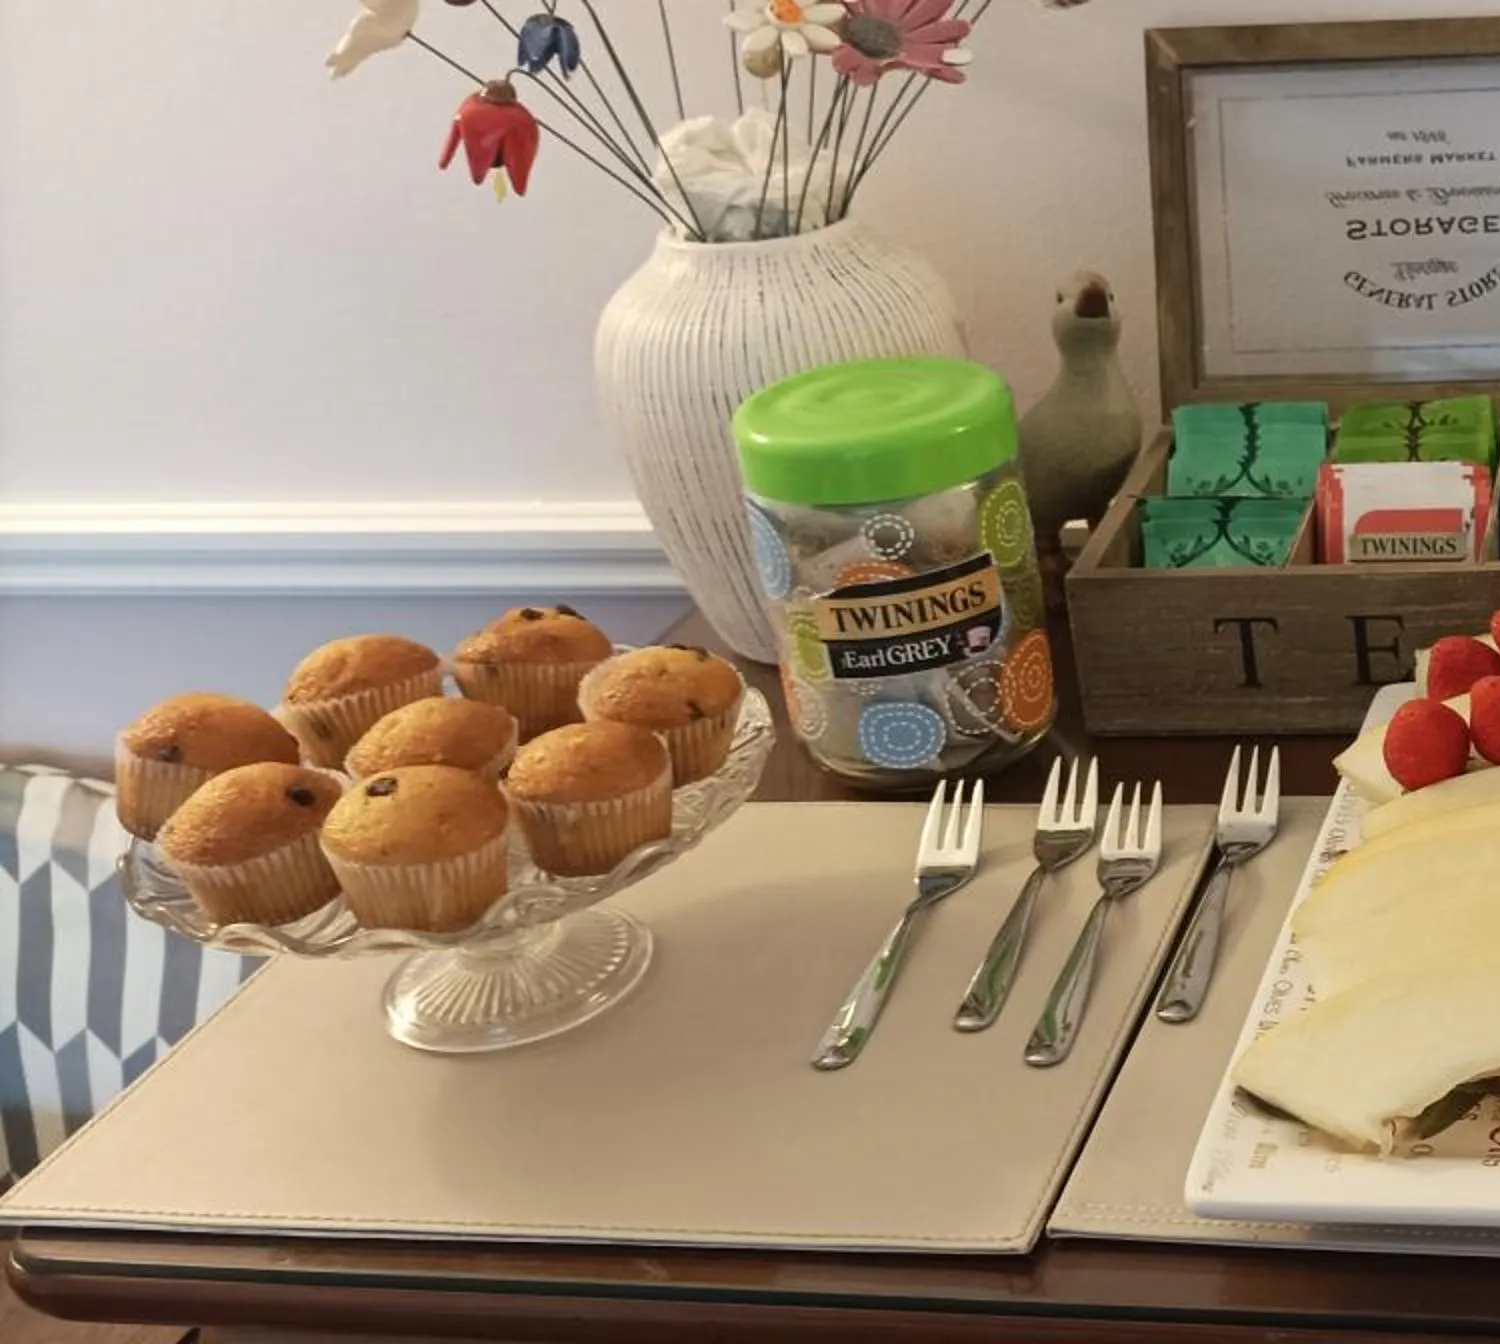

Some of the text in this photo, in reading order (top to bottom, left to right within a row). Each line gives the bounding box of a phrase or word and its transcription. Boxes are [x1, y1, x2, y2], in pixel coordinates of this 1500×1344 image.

[1360, 537, 1458, 556] TWININGS
[830, 579, 987, 634] TWININGS
[1213, 613, 1416, 689] TE
